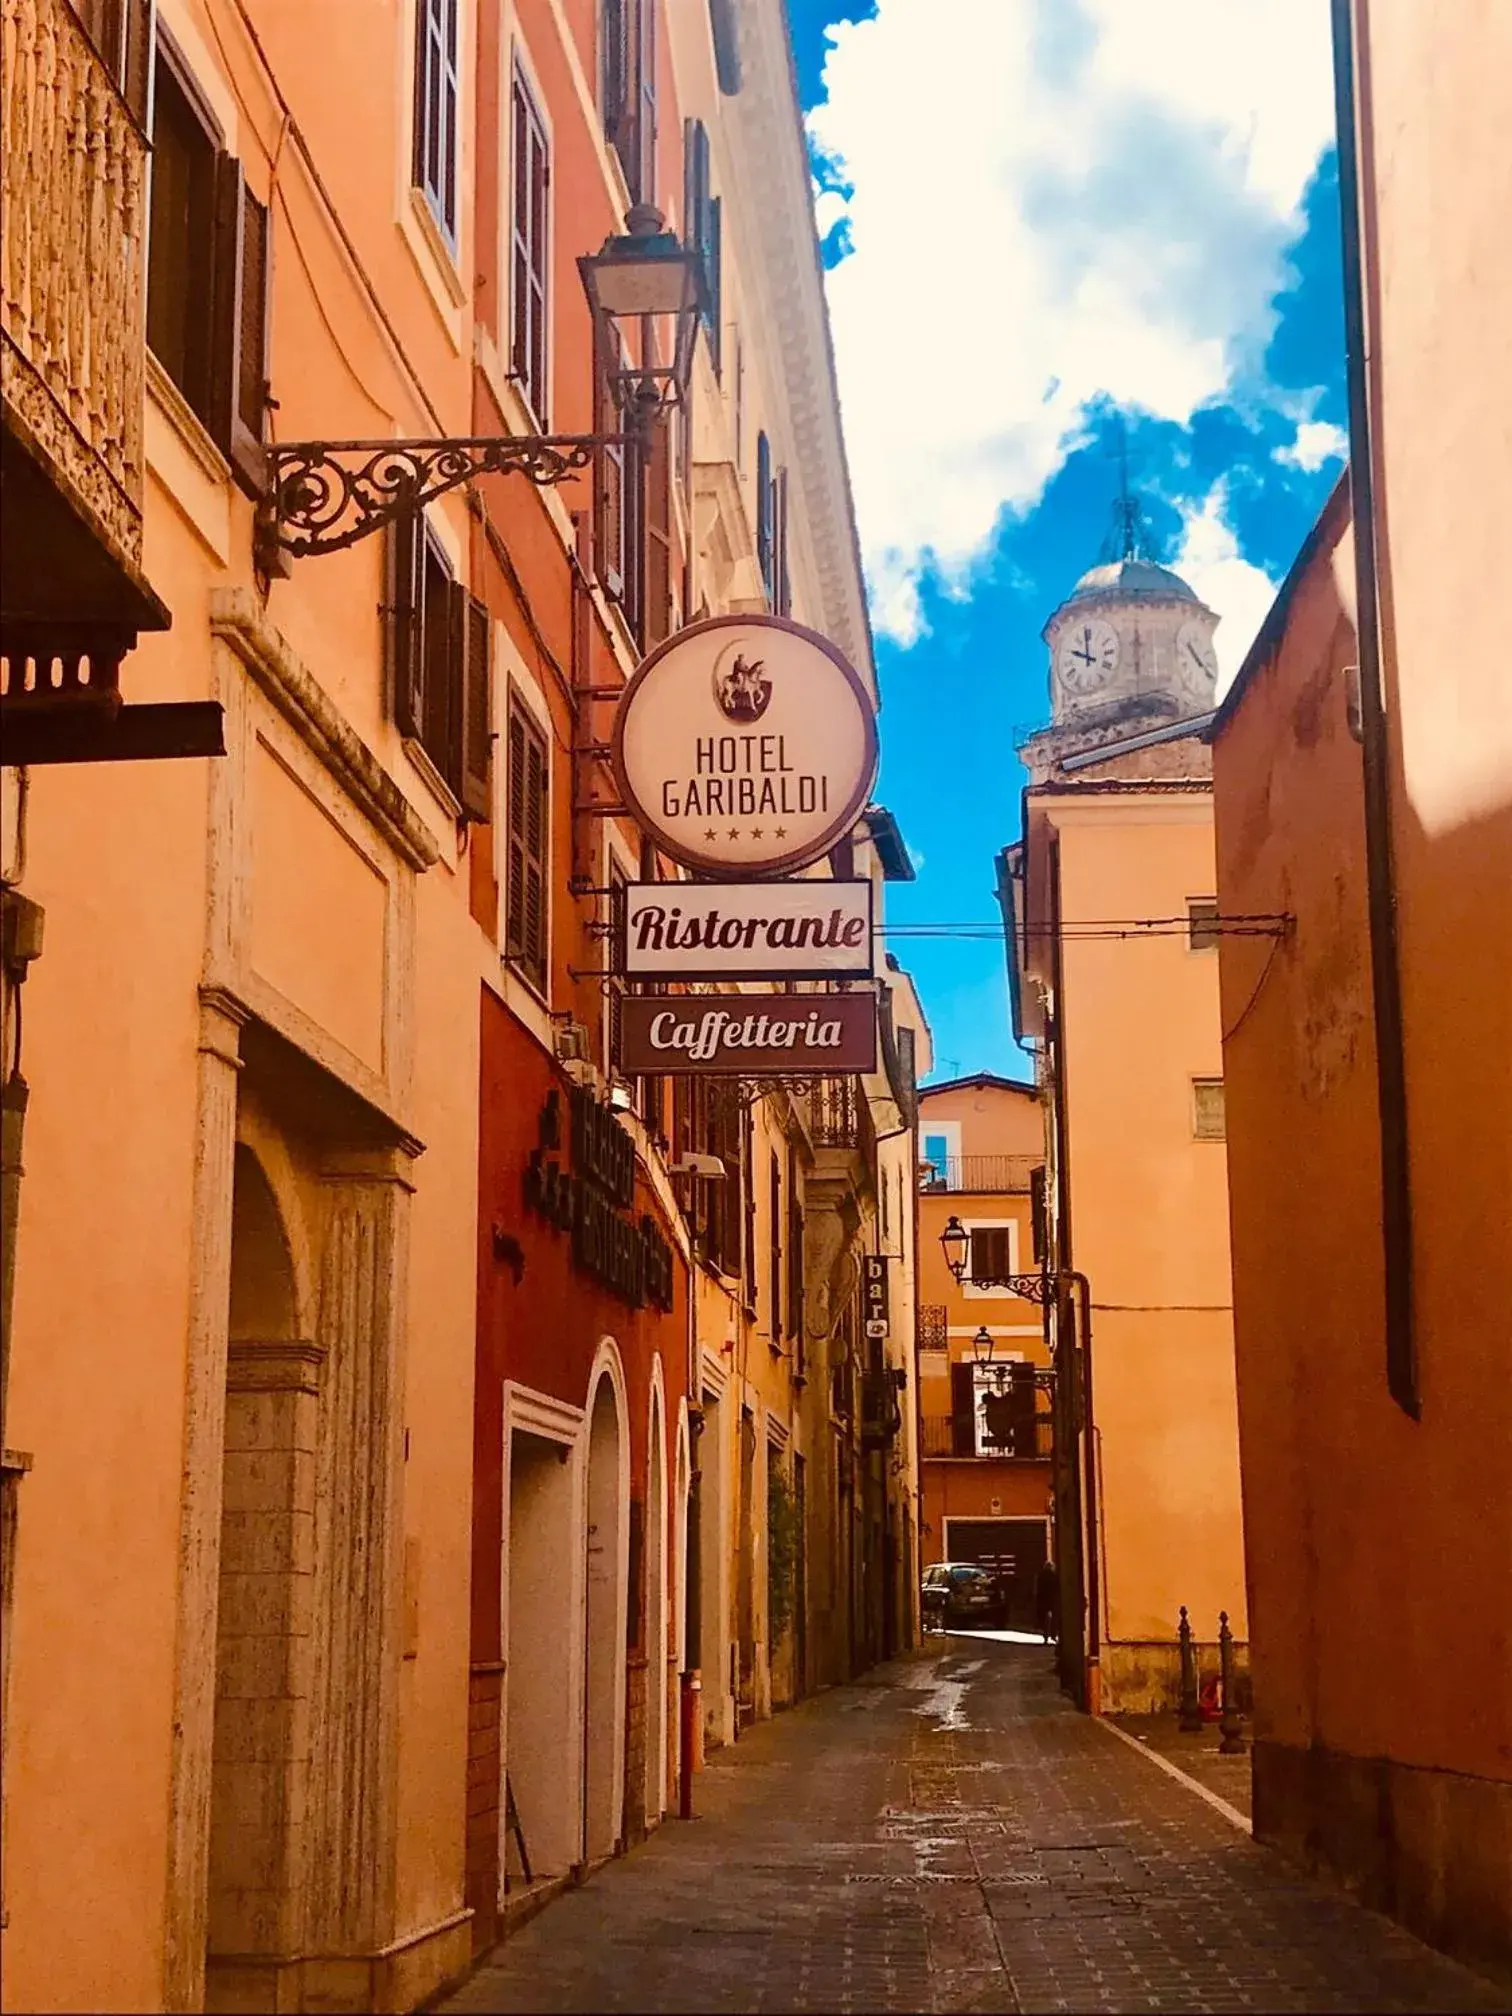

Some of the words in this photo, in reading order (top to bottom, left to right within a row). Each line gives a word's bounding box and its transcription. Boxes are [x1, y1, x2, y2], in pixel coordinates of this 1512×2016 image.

[696, 735, 794, 774] HOTEL
[662, 775, 828, 817] GARIBALDI
[631, 905, 866, 950] Ristorante
[649, 1011, 842, 1061] Caffetteria
[868, 1258, 884, 1319] bar
